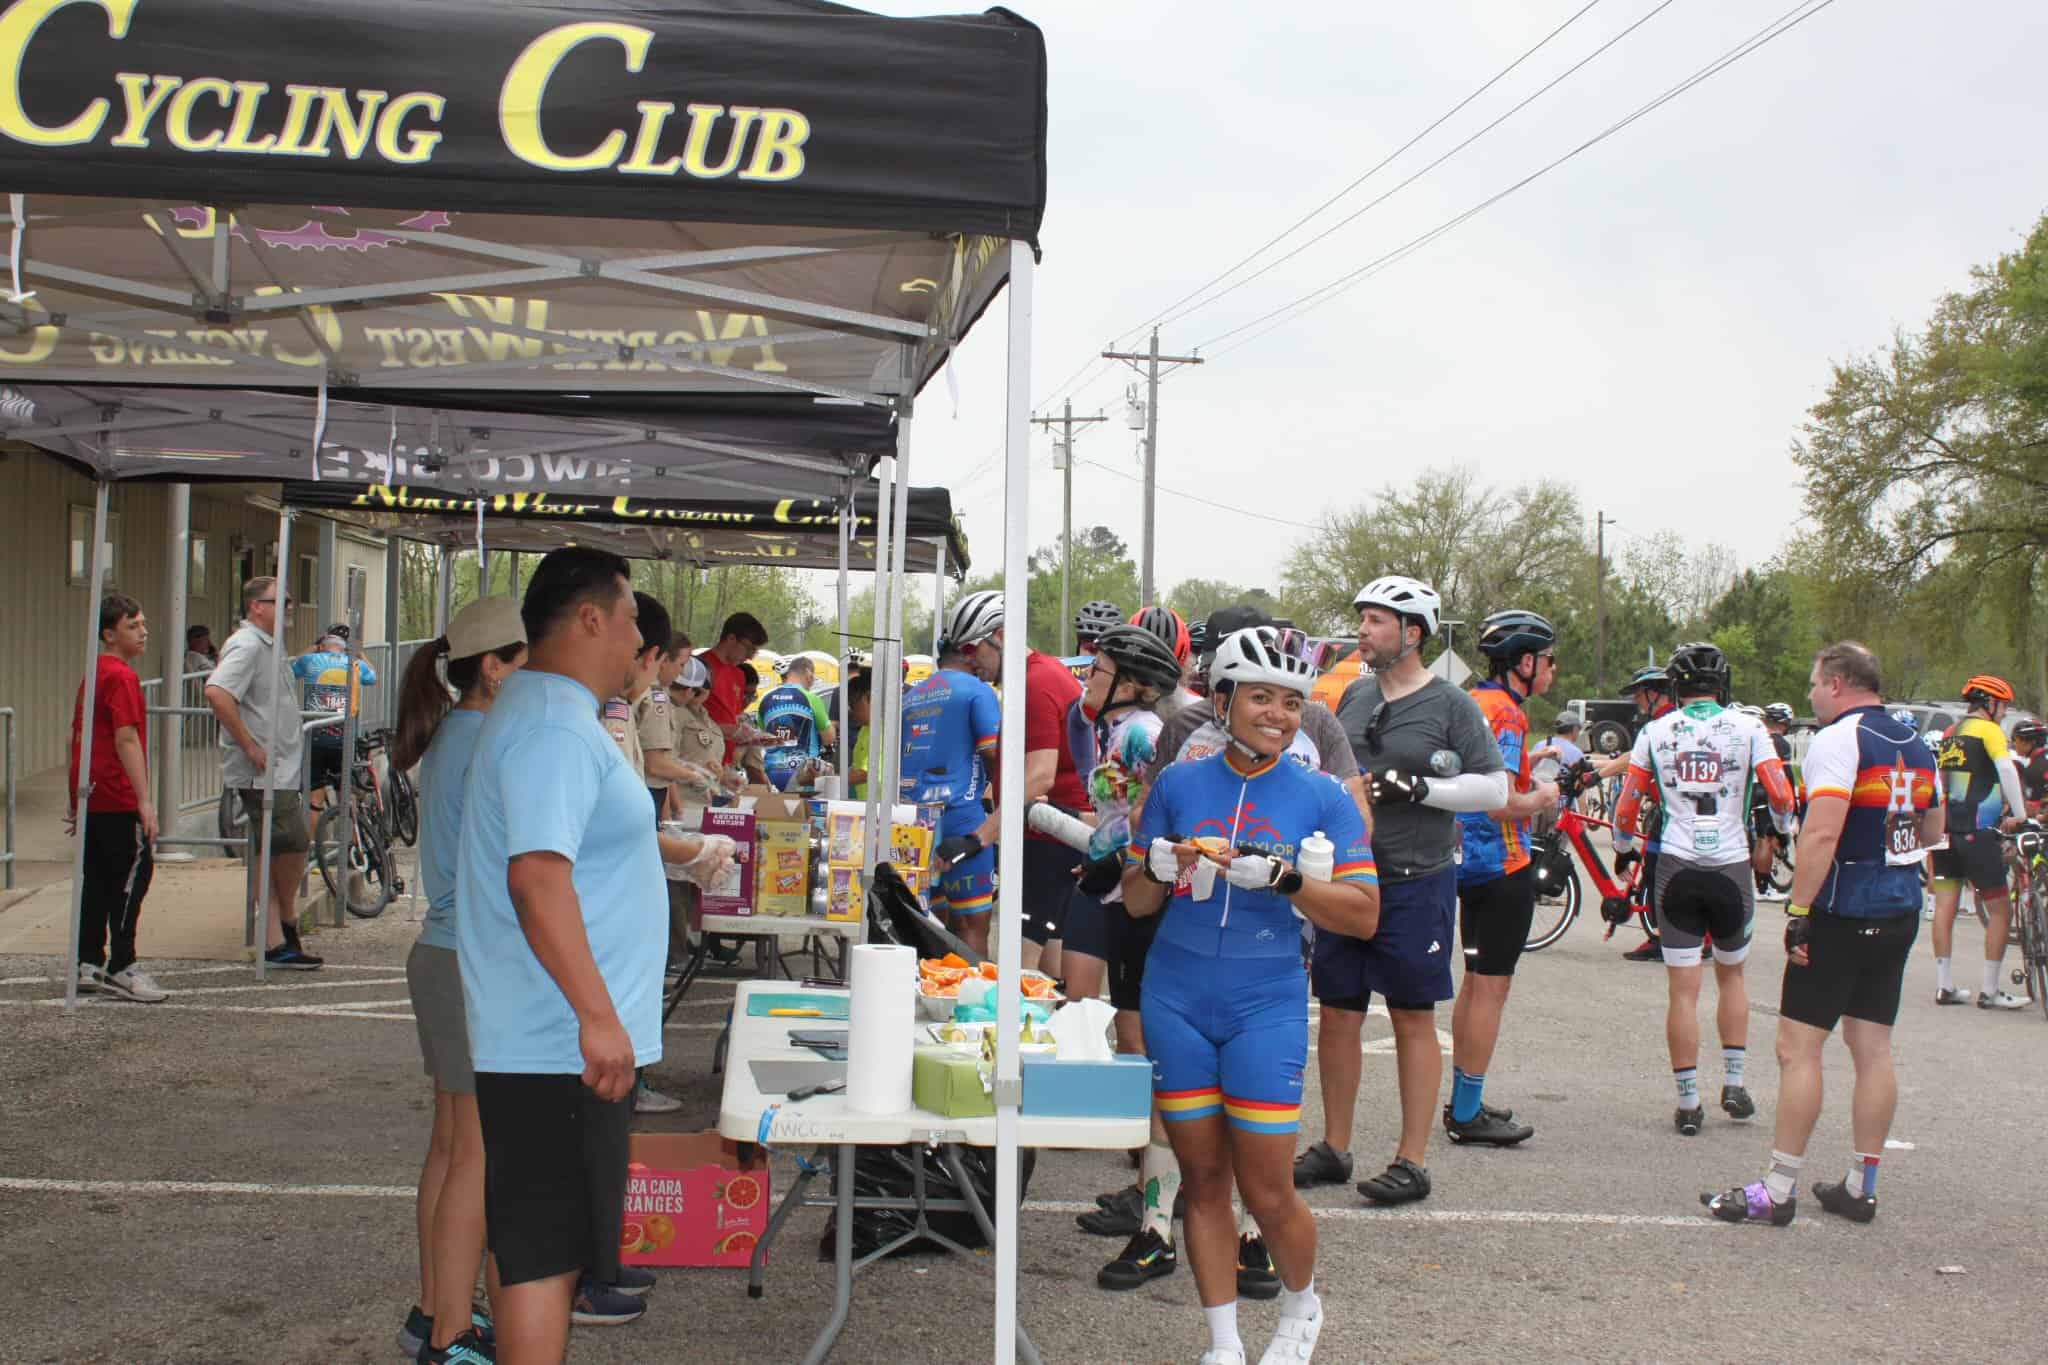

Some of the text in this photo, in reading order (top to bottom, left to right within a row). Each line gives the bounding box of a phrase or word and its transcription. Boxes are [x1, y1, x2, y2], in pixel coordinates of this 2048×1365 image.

[1680, 760, 1718, 780] 1139
[1888, 771, 1915, 812] H
[1893, 827, 1916, 852] 836
[625, 1179, 682, 1195] ARA CARA
[624, 1196, 683, 1213] RANGES
